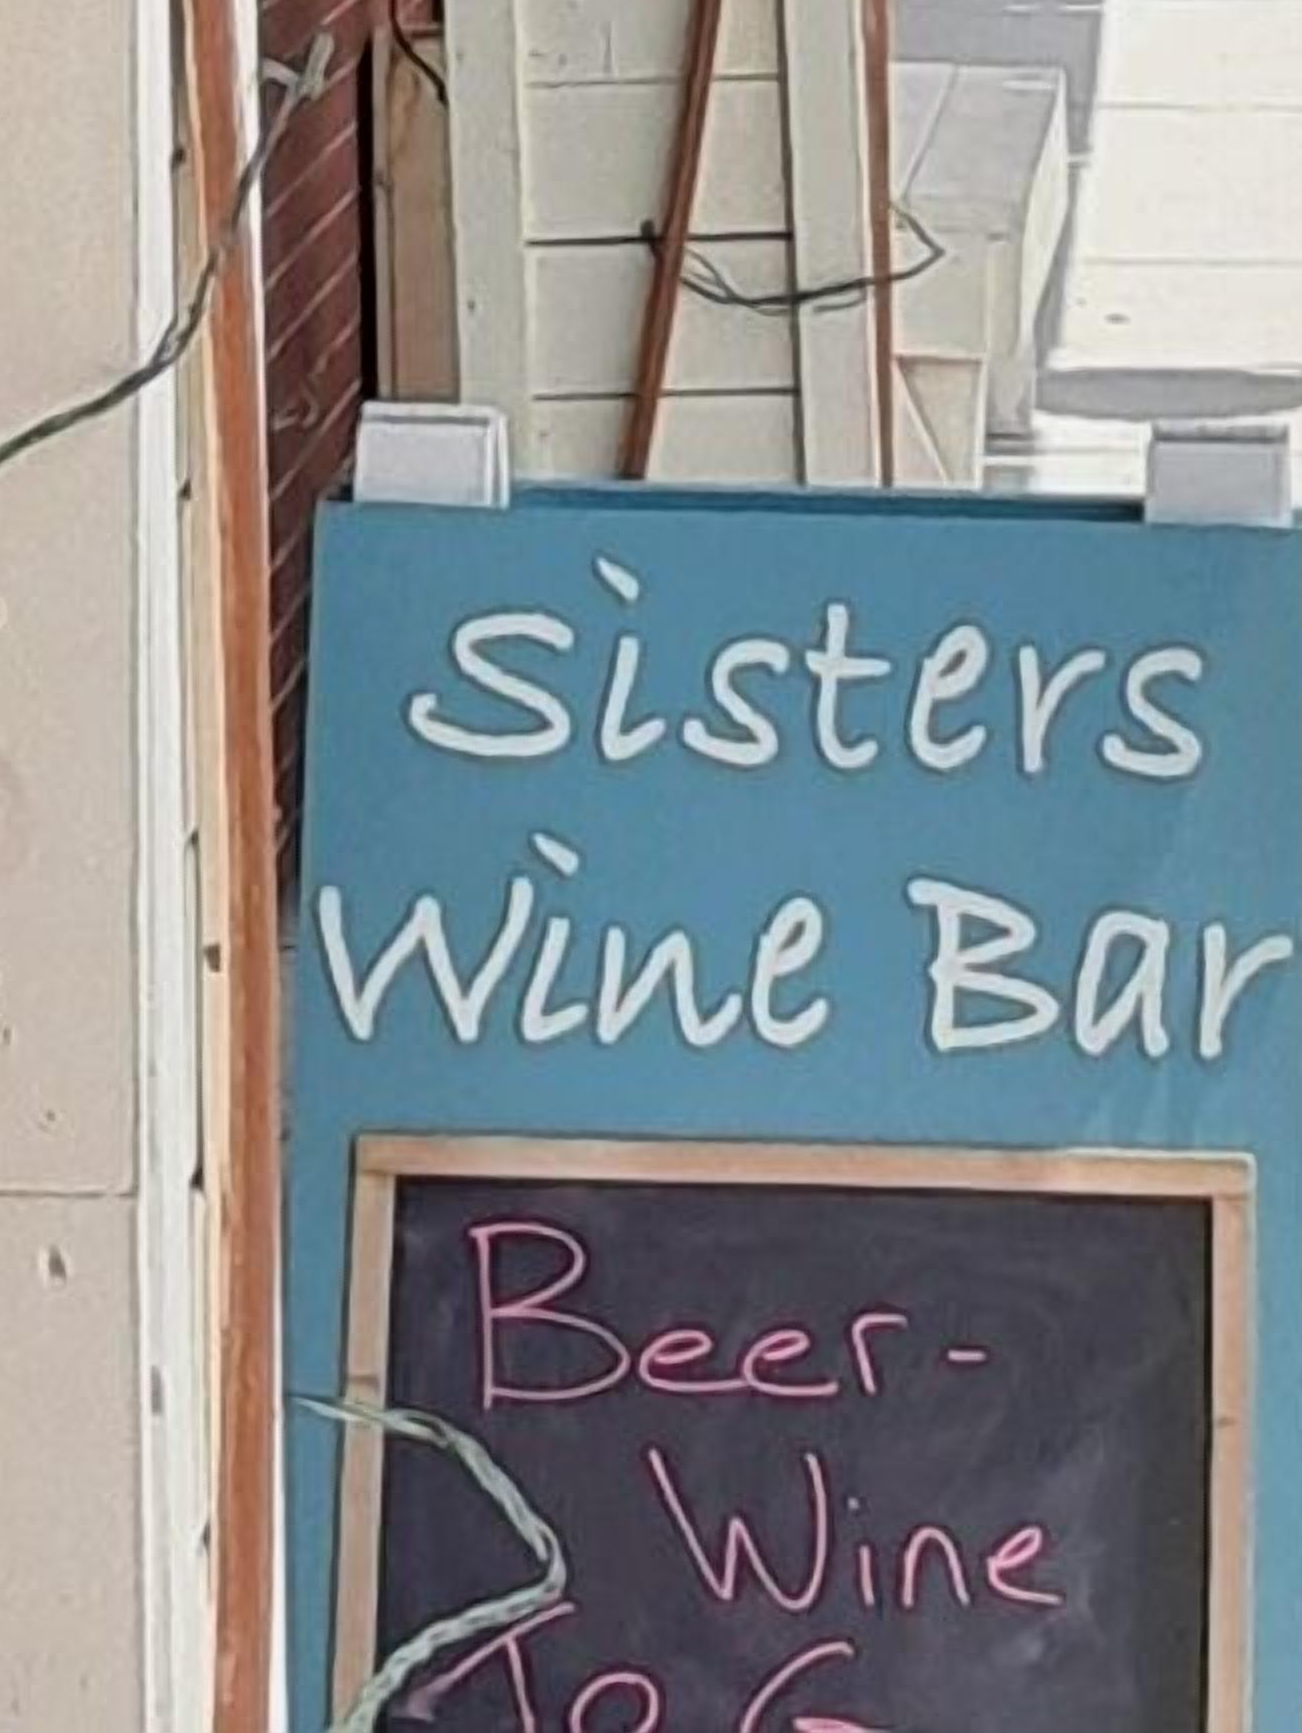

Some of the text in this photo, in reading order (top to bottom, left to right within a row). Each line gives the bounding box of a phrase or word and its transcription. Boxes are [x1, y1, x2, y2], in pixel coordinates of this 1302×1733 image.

[405, 555, 1205, 781] Sisters
[317, 830, 1294, 1061] Wine Bar
[645, 1446, 1064, 1611] Wine
